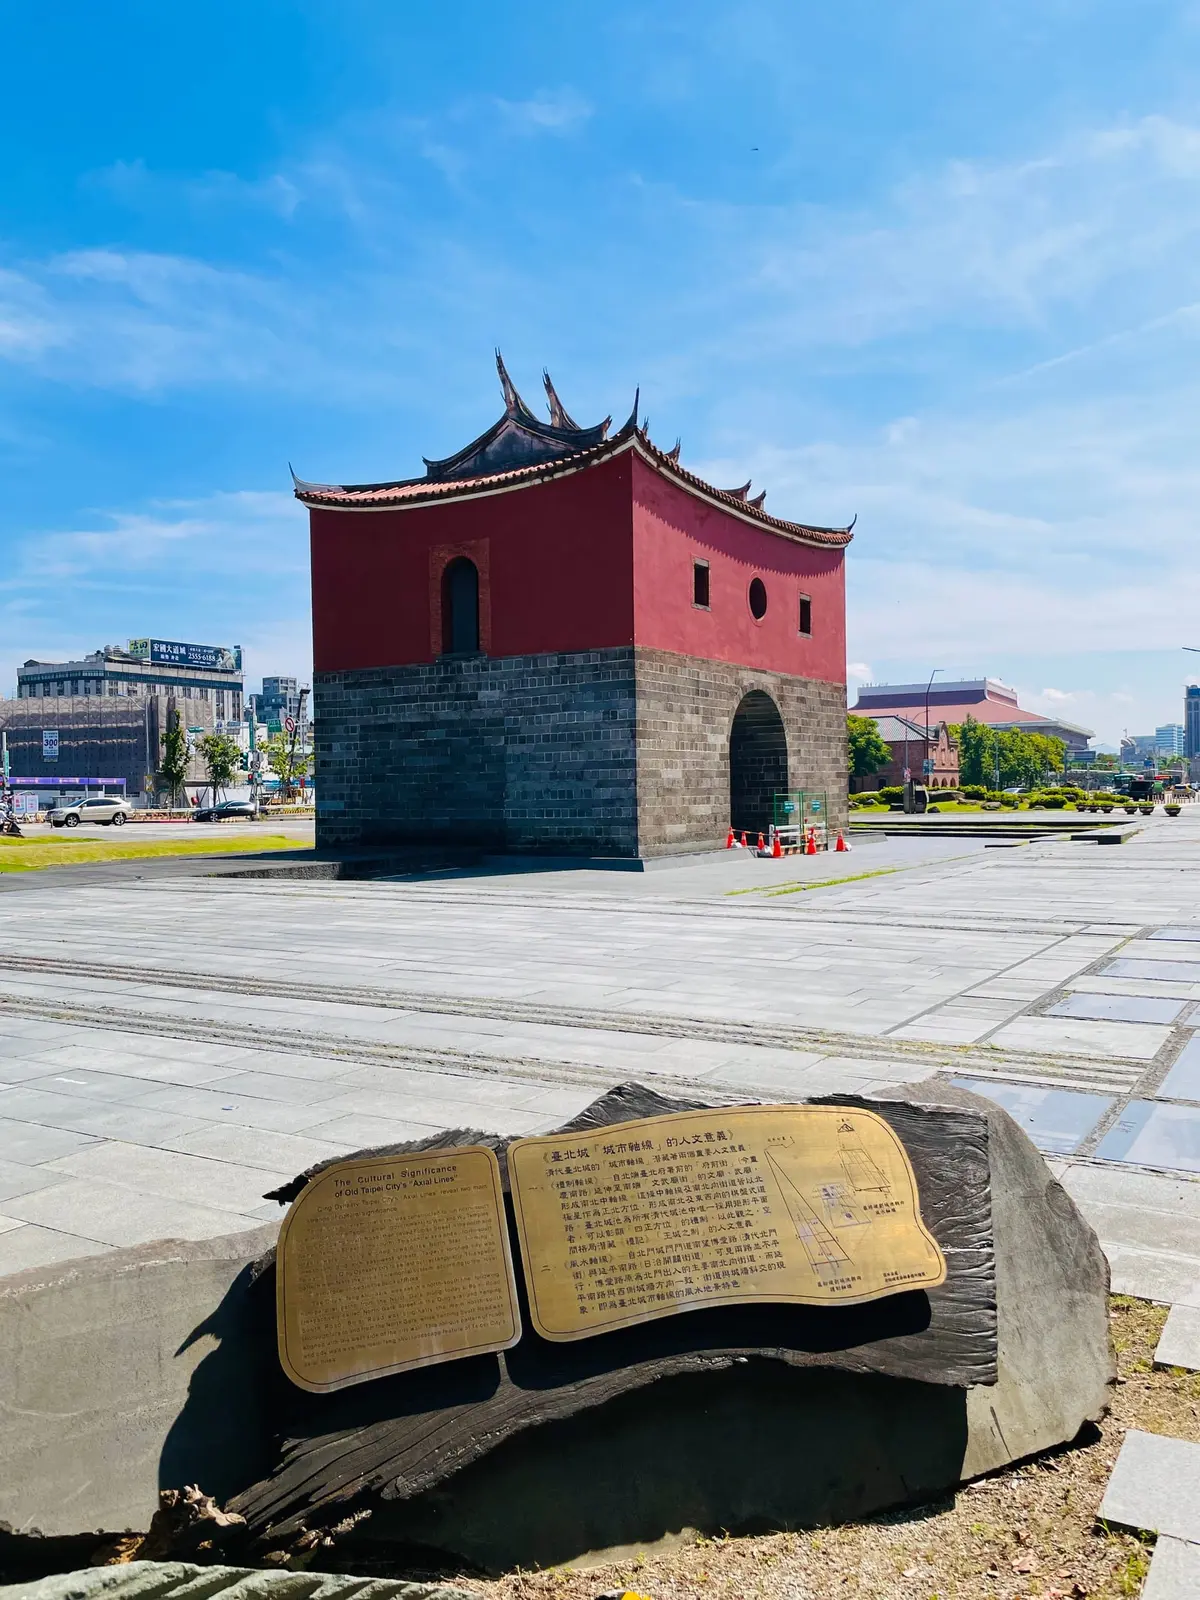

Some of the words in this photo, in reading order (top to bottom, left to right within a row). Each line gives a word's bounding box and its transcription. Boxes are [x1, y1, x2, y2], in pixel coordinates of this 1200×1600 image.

[334, 1178, 351, 1188] The
[357, 1172, 395, 1185] Cultural
[401, 1165, 457, 1179] Significance
[335, 1189, 343, 1198] of
[344, 1186, 359, 1197] Old
[361, 1183, 384, 1195] Taipei
[385, 1180, 407, 1192] City's
[409, 1177, 432, 1189] "Axial
[433, 1174, 458, 1186] Lines"
